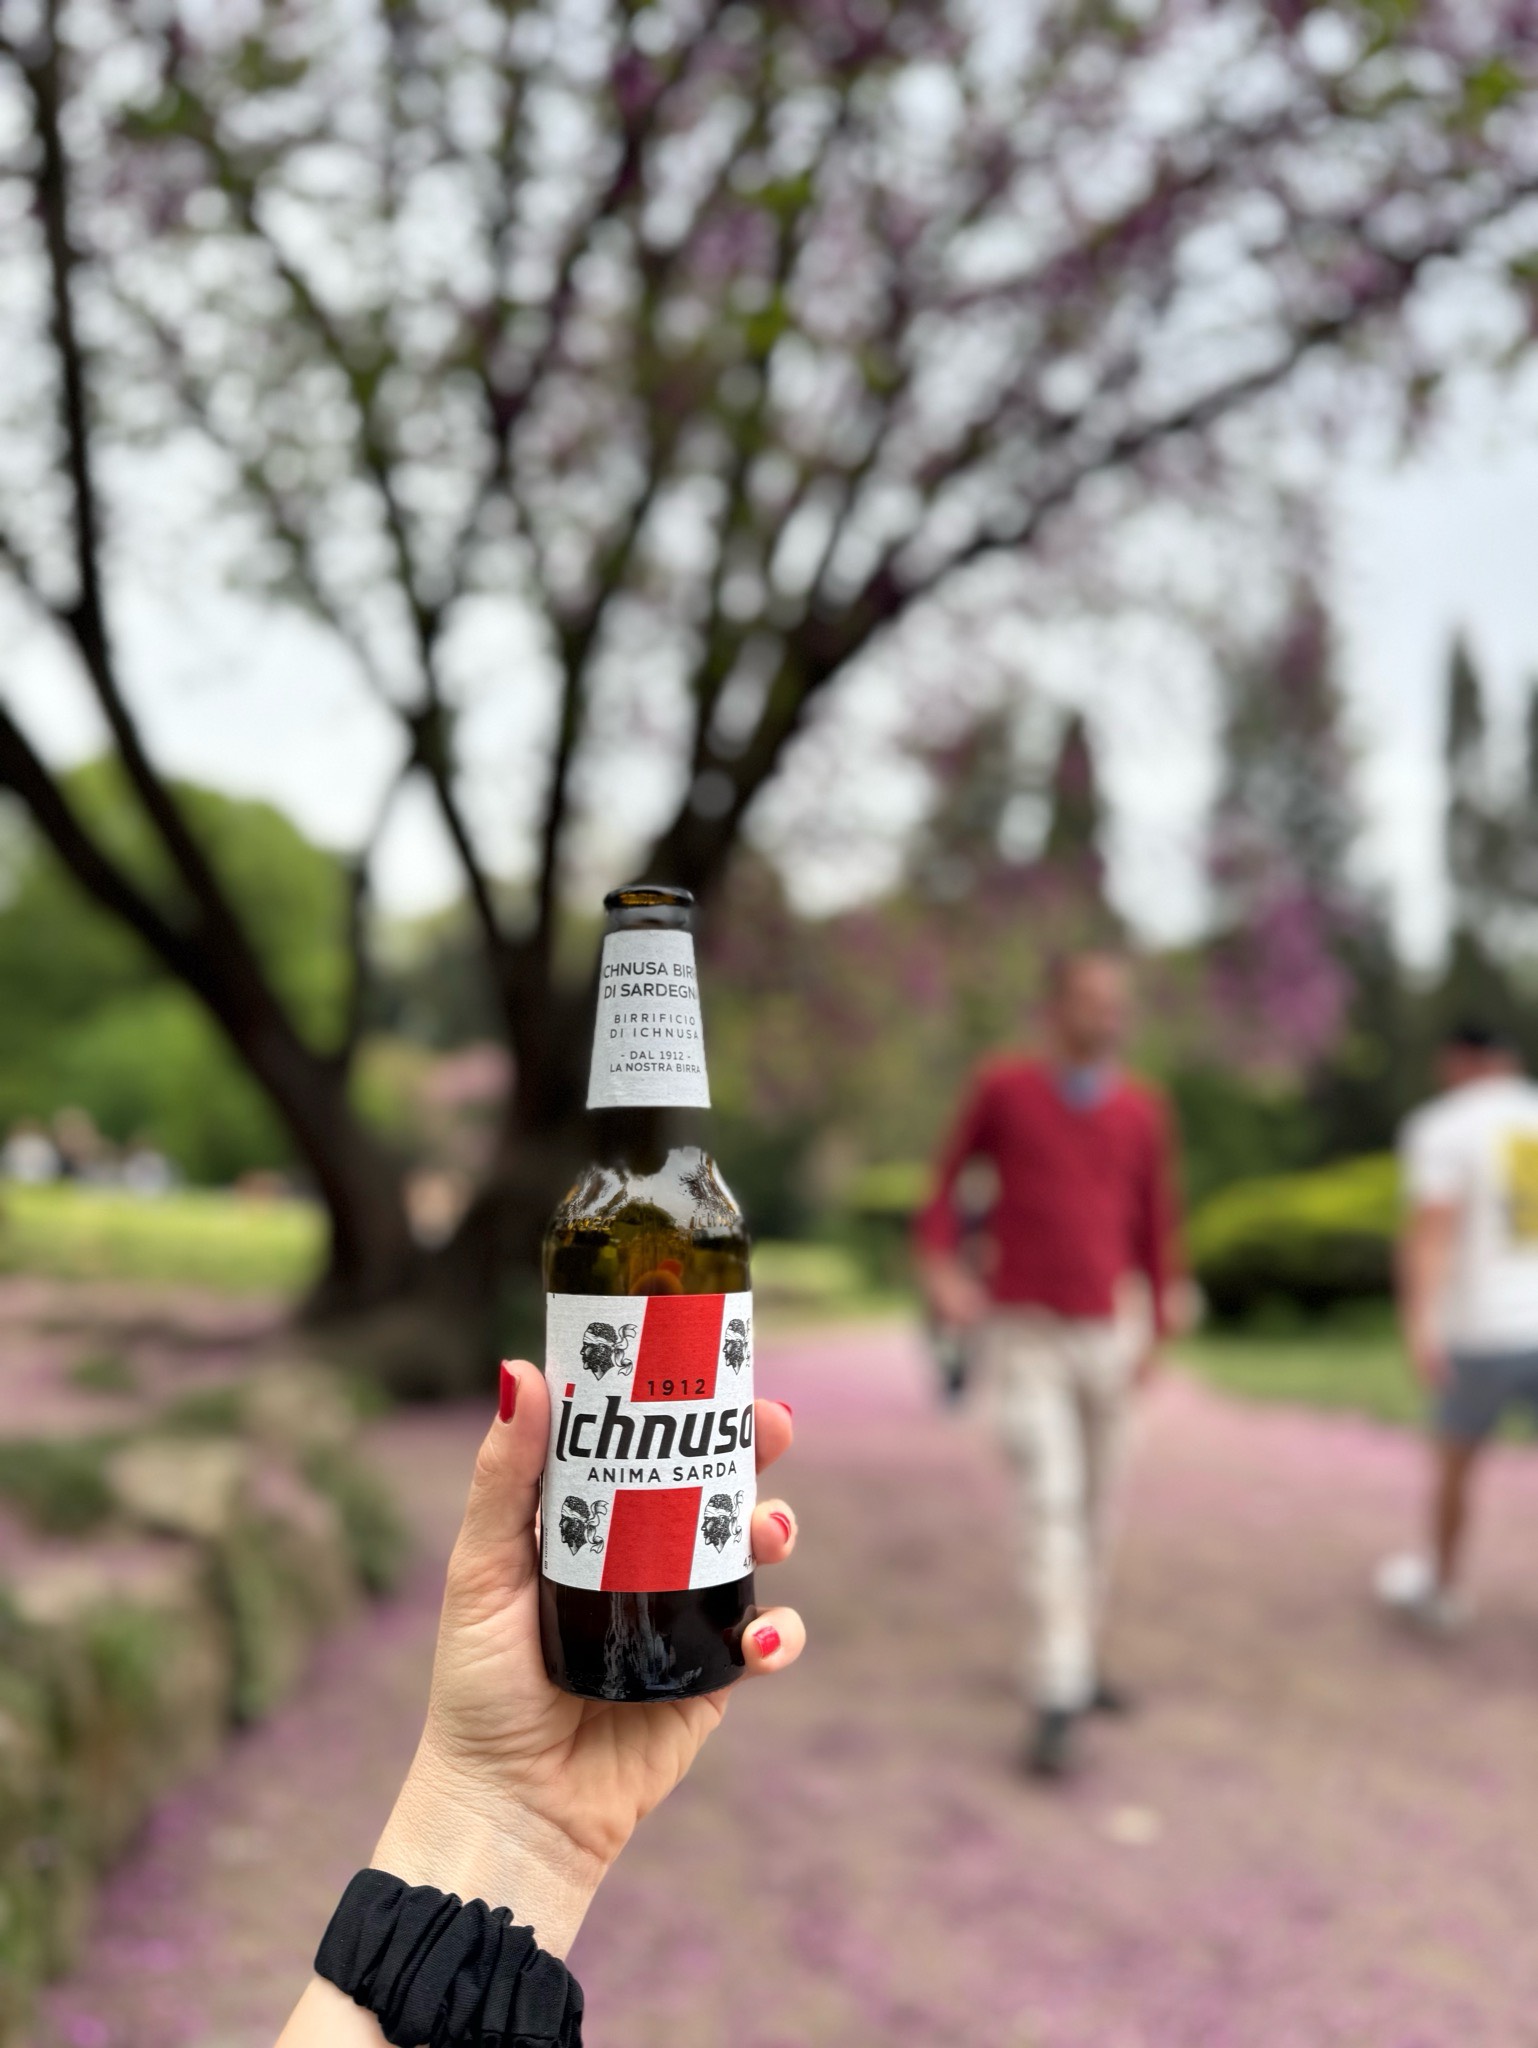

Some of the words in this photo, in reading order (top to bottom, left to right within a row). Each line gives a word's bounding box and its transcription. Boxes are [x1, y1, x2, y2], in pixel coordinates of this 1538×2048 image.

[673, 963, 696, 979] BIR
[604, 985, 616, 999] DI
[621, 983, 698, 1000] SARDEGN
[614, 1013, 696, 1026] BIRRIFICIO
[610, 1028, 624, 1039] DI
[633, 1027, 699, 1040] ICHNUSA
[630, 1050, 655, 1060] DAL
[660, 1050, 684, 1061] 1912
[610, 1063, 622, 1073] LA
[625, 1062, 673, 1072] NOSTRA
[676, 1063, 701, 1074] BIRRA
[647, 1378, 706, 1396] 1912
[556, 1383, 753, 1462] ichnusa
[587, 1466, 661, 1483] ANIMA
[673, 1460, 737, 1482] SARDA
